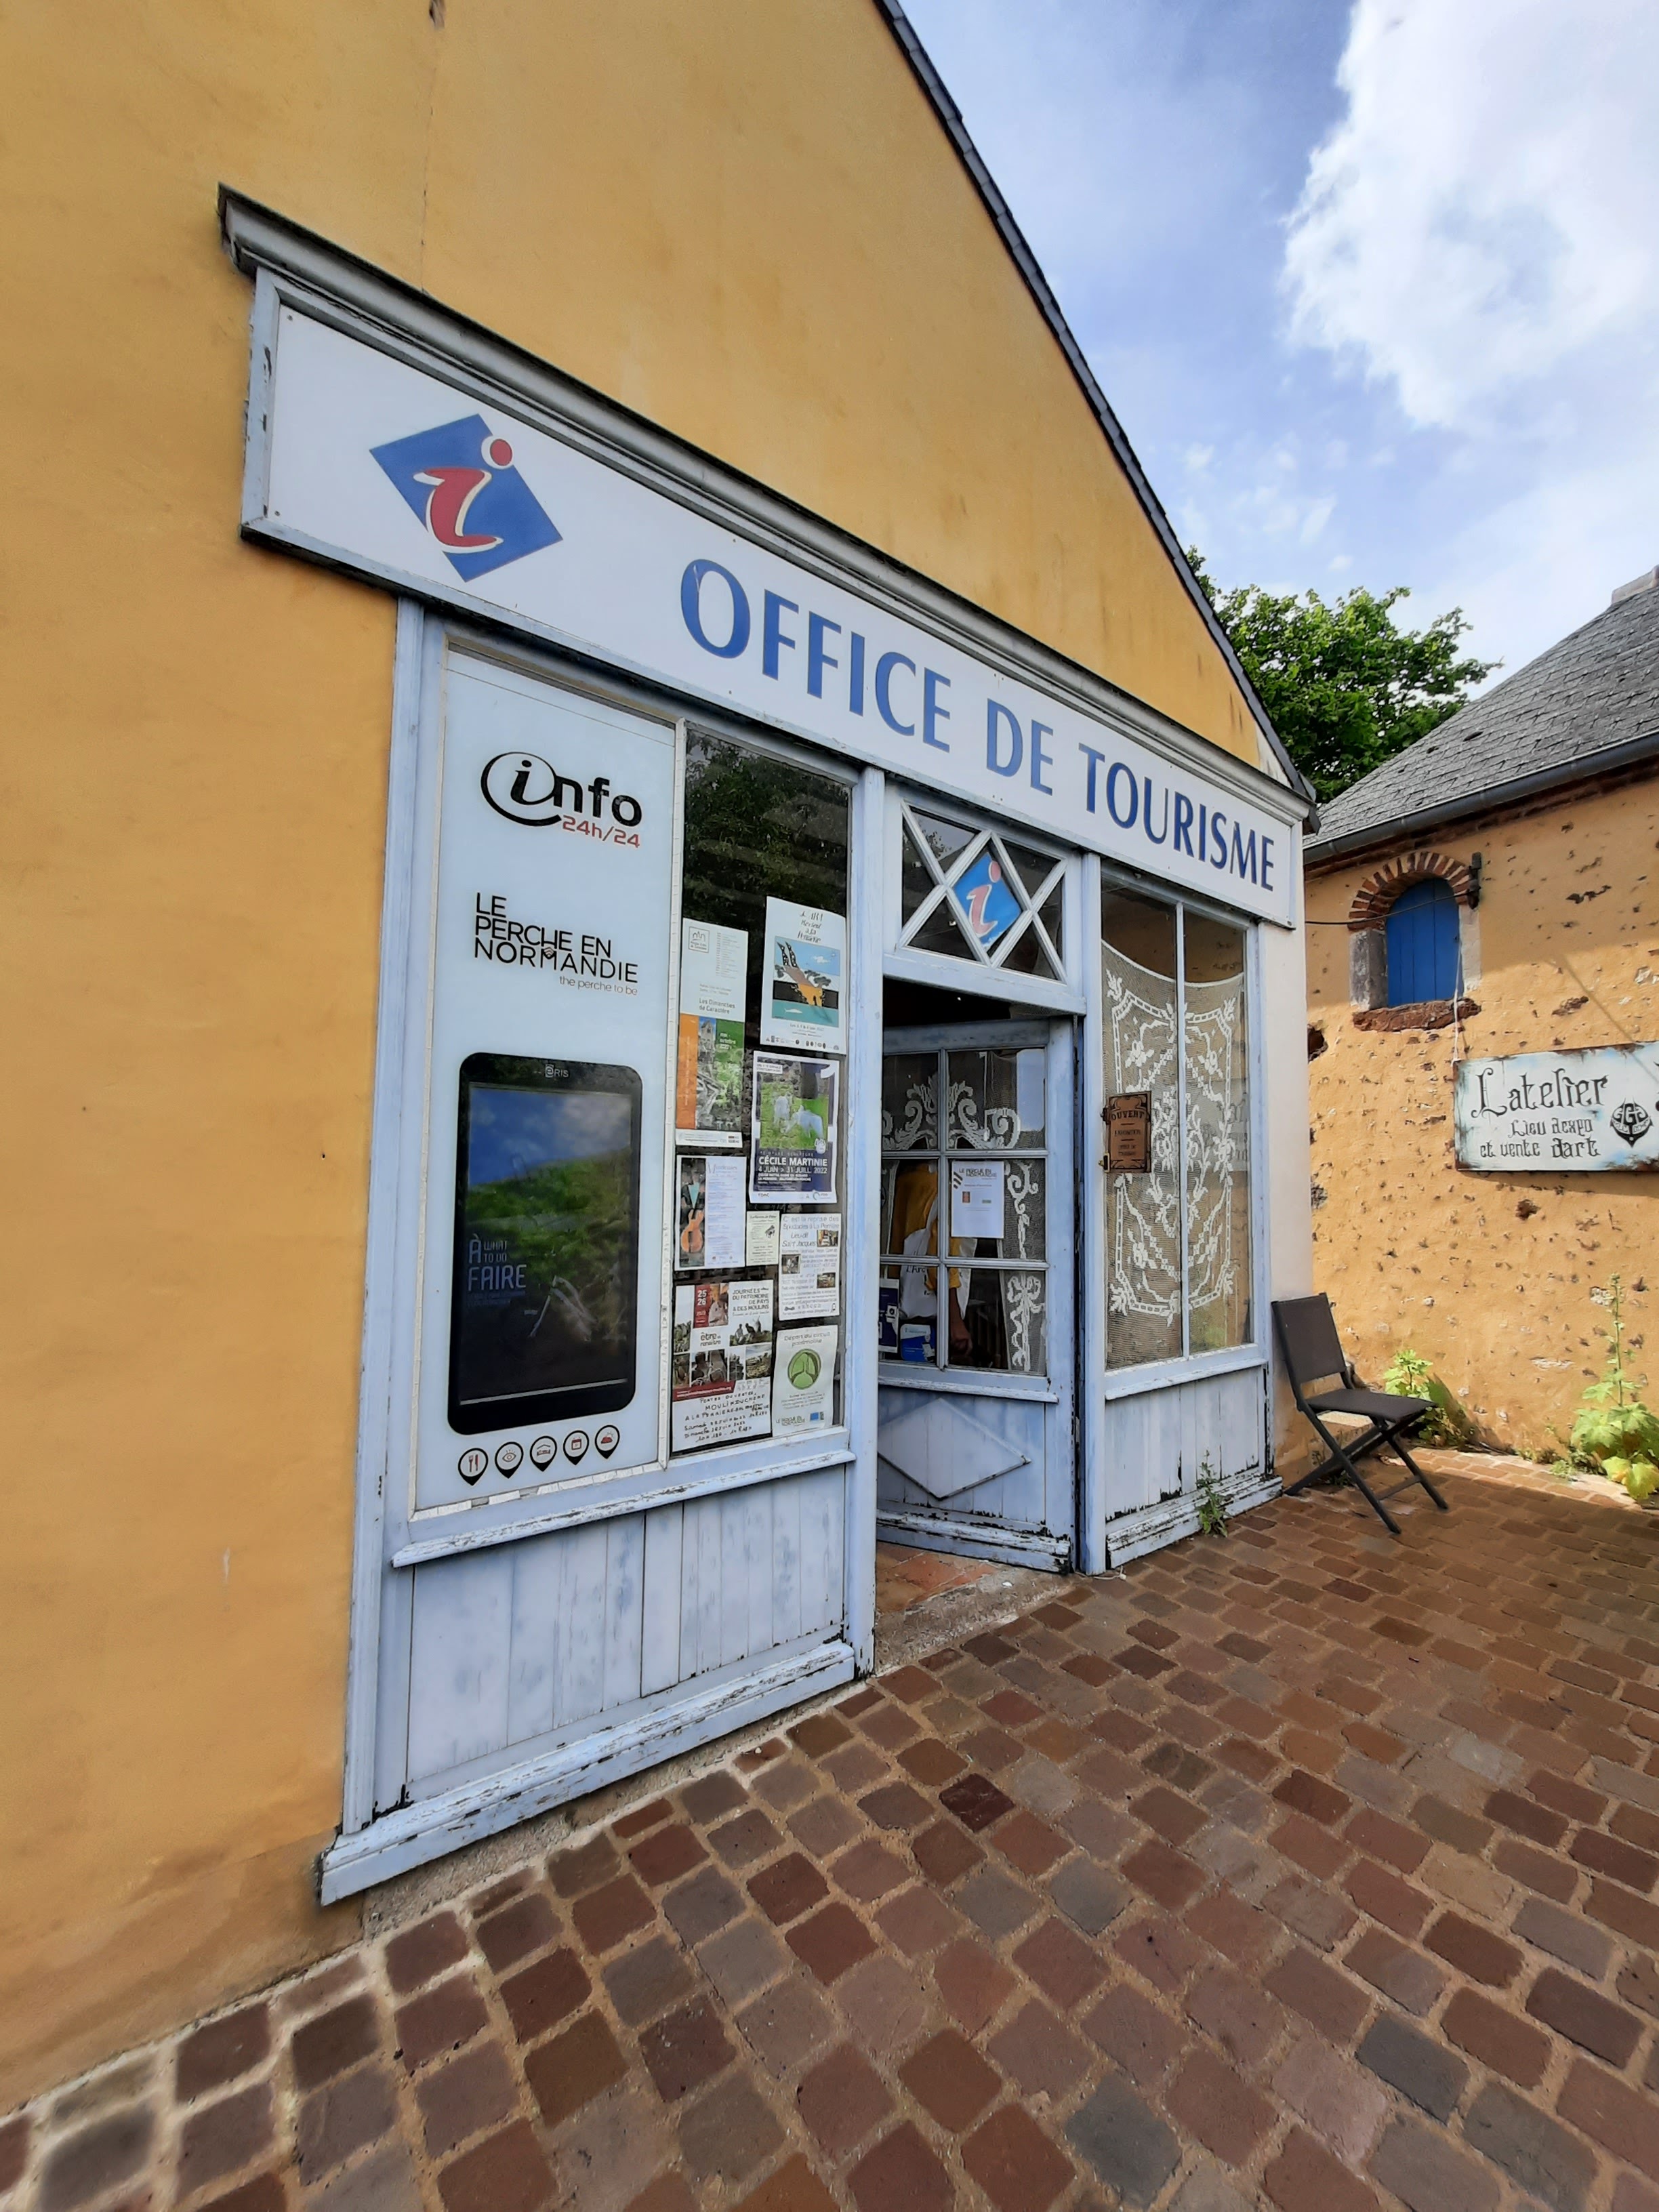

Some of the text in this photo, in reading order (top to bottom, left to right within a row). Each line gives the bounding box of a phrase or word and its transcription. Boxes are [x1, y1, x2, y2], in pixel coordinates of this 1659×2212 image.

[680, 558, 1275, 891] OFFICE DE TOURISME
[562, 815, 640, 848] 24h/24
[476, 893, 508, 918] LE
[475, 916, 611, 958] PERCHE EN
[474, 938, 638, 983] NORMANDIE
[559, 975, 638, 996] the perche to be
[1111, 1110, 1145, 1120] OUVERT
[1508, 1119, 1547, 1138] Lieu
[1479, 1140, 1496, 1158] et
[1500, 1139, 1542, 1158] vente
[758, 1155, 827, 1166] CÉCILE MARTINIE
[468, 1233, 482, 1264] À
[484, 1240, 508, 1250] WHAT
[484, 1253, 494, 1263] TO
[468, 1265, 527, 1291] FAIRE
[700, 1332, 717, 1341] être
